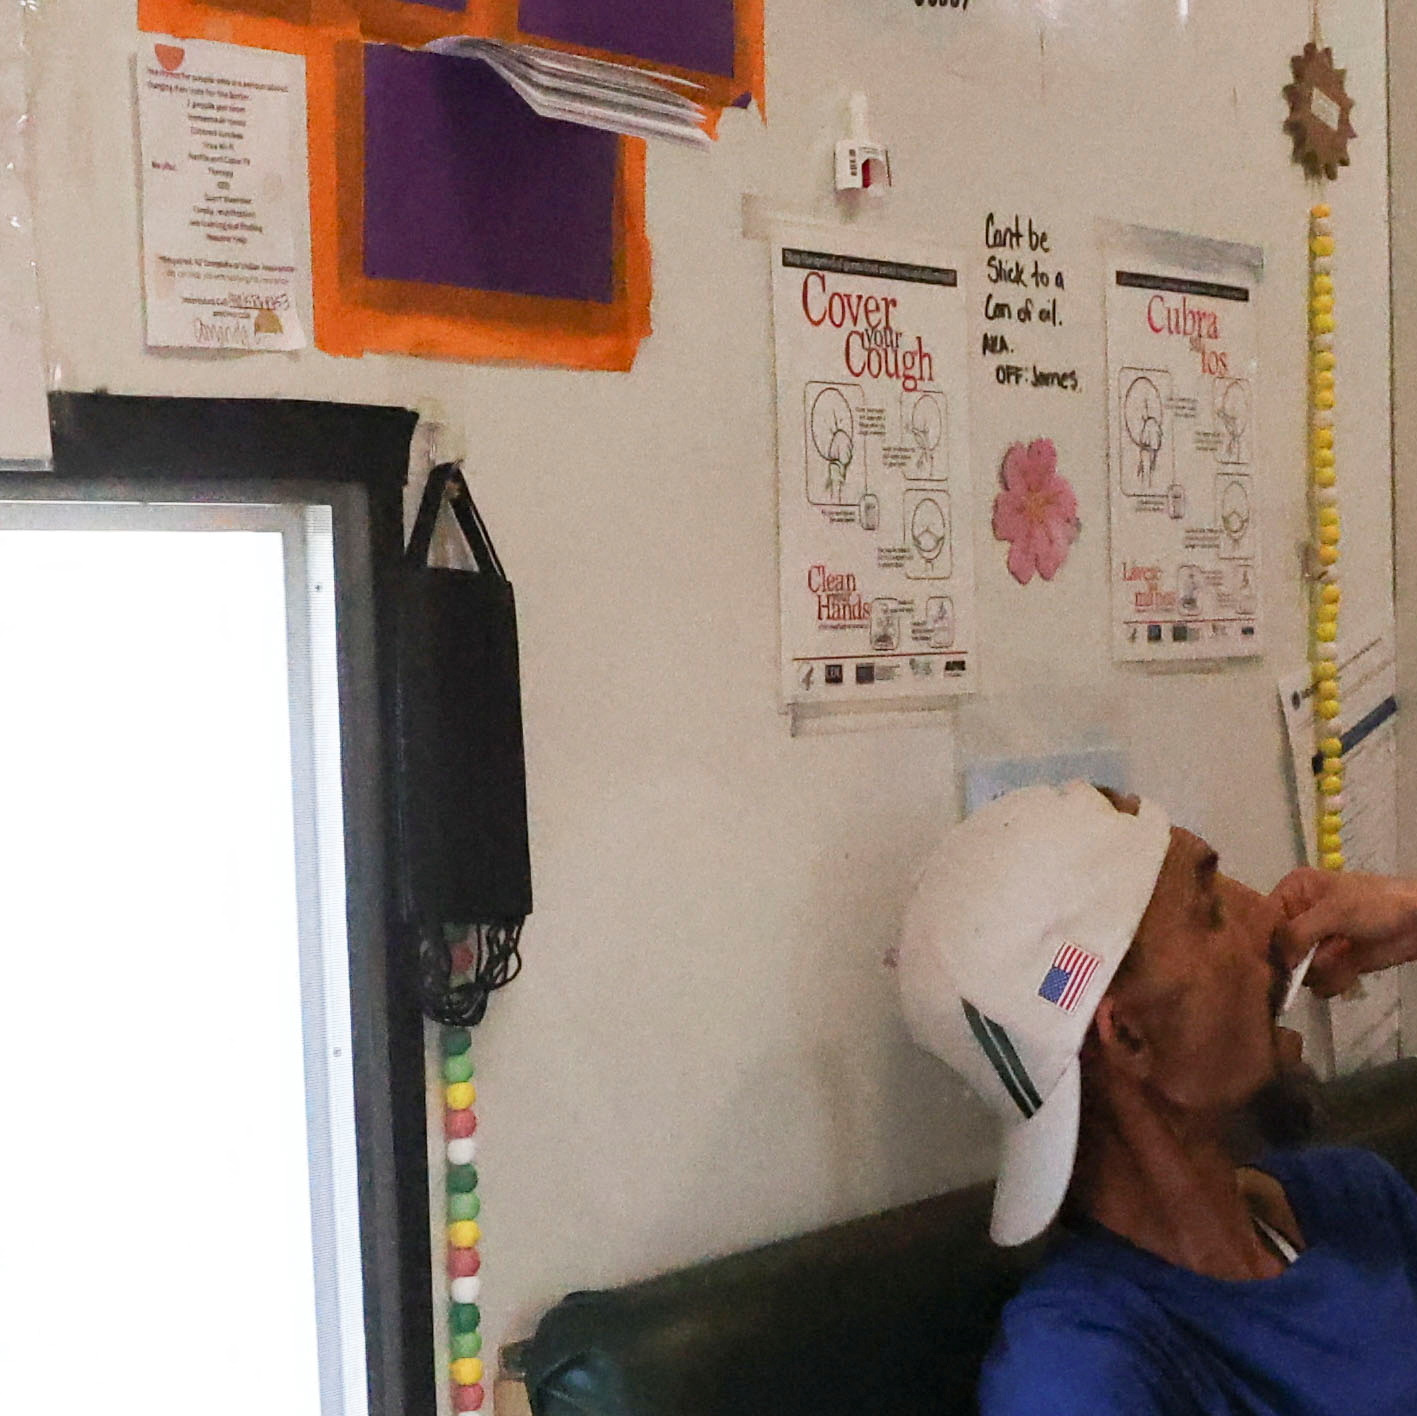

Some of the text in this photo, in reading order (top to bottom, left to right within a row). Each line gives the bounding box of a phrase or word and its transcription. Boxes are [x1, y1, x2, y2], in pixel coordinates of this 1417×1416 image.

[1029, 217, 1050, 253] be
[1031, 260, 1050, 288] to
[1055, 271, 1065, 291] a
[802, 271, 897, 329] Cover
[1017, 297, 1034, 323] of
[1147, 294, 1219, 339] Cubra
[865, 327, 903, 350] your
[844, 330, 935, 392] Cough
[807, 564, 857, 593] Clean
[817, 593, 872, 621] Hands
